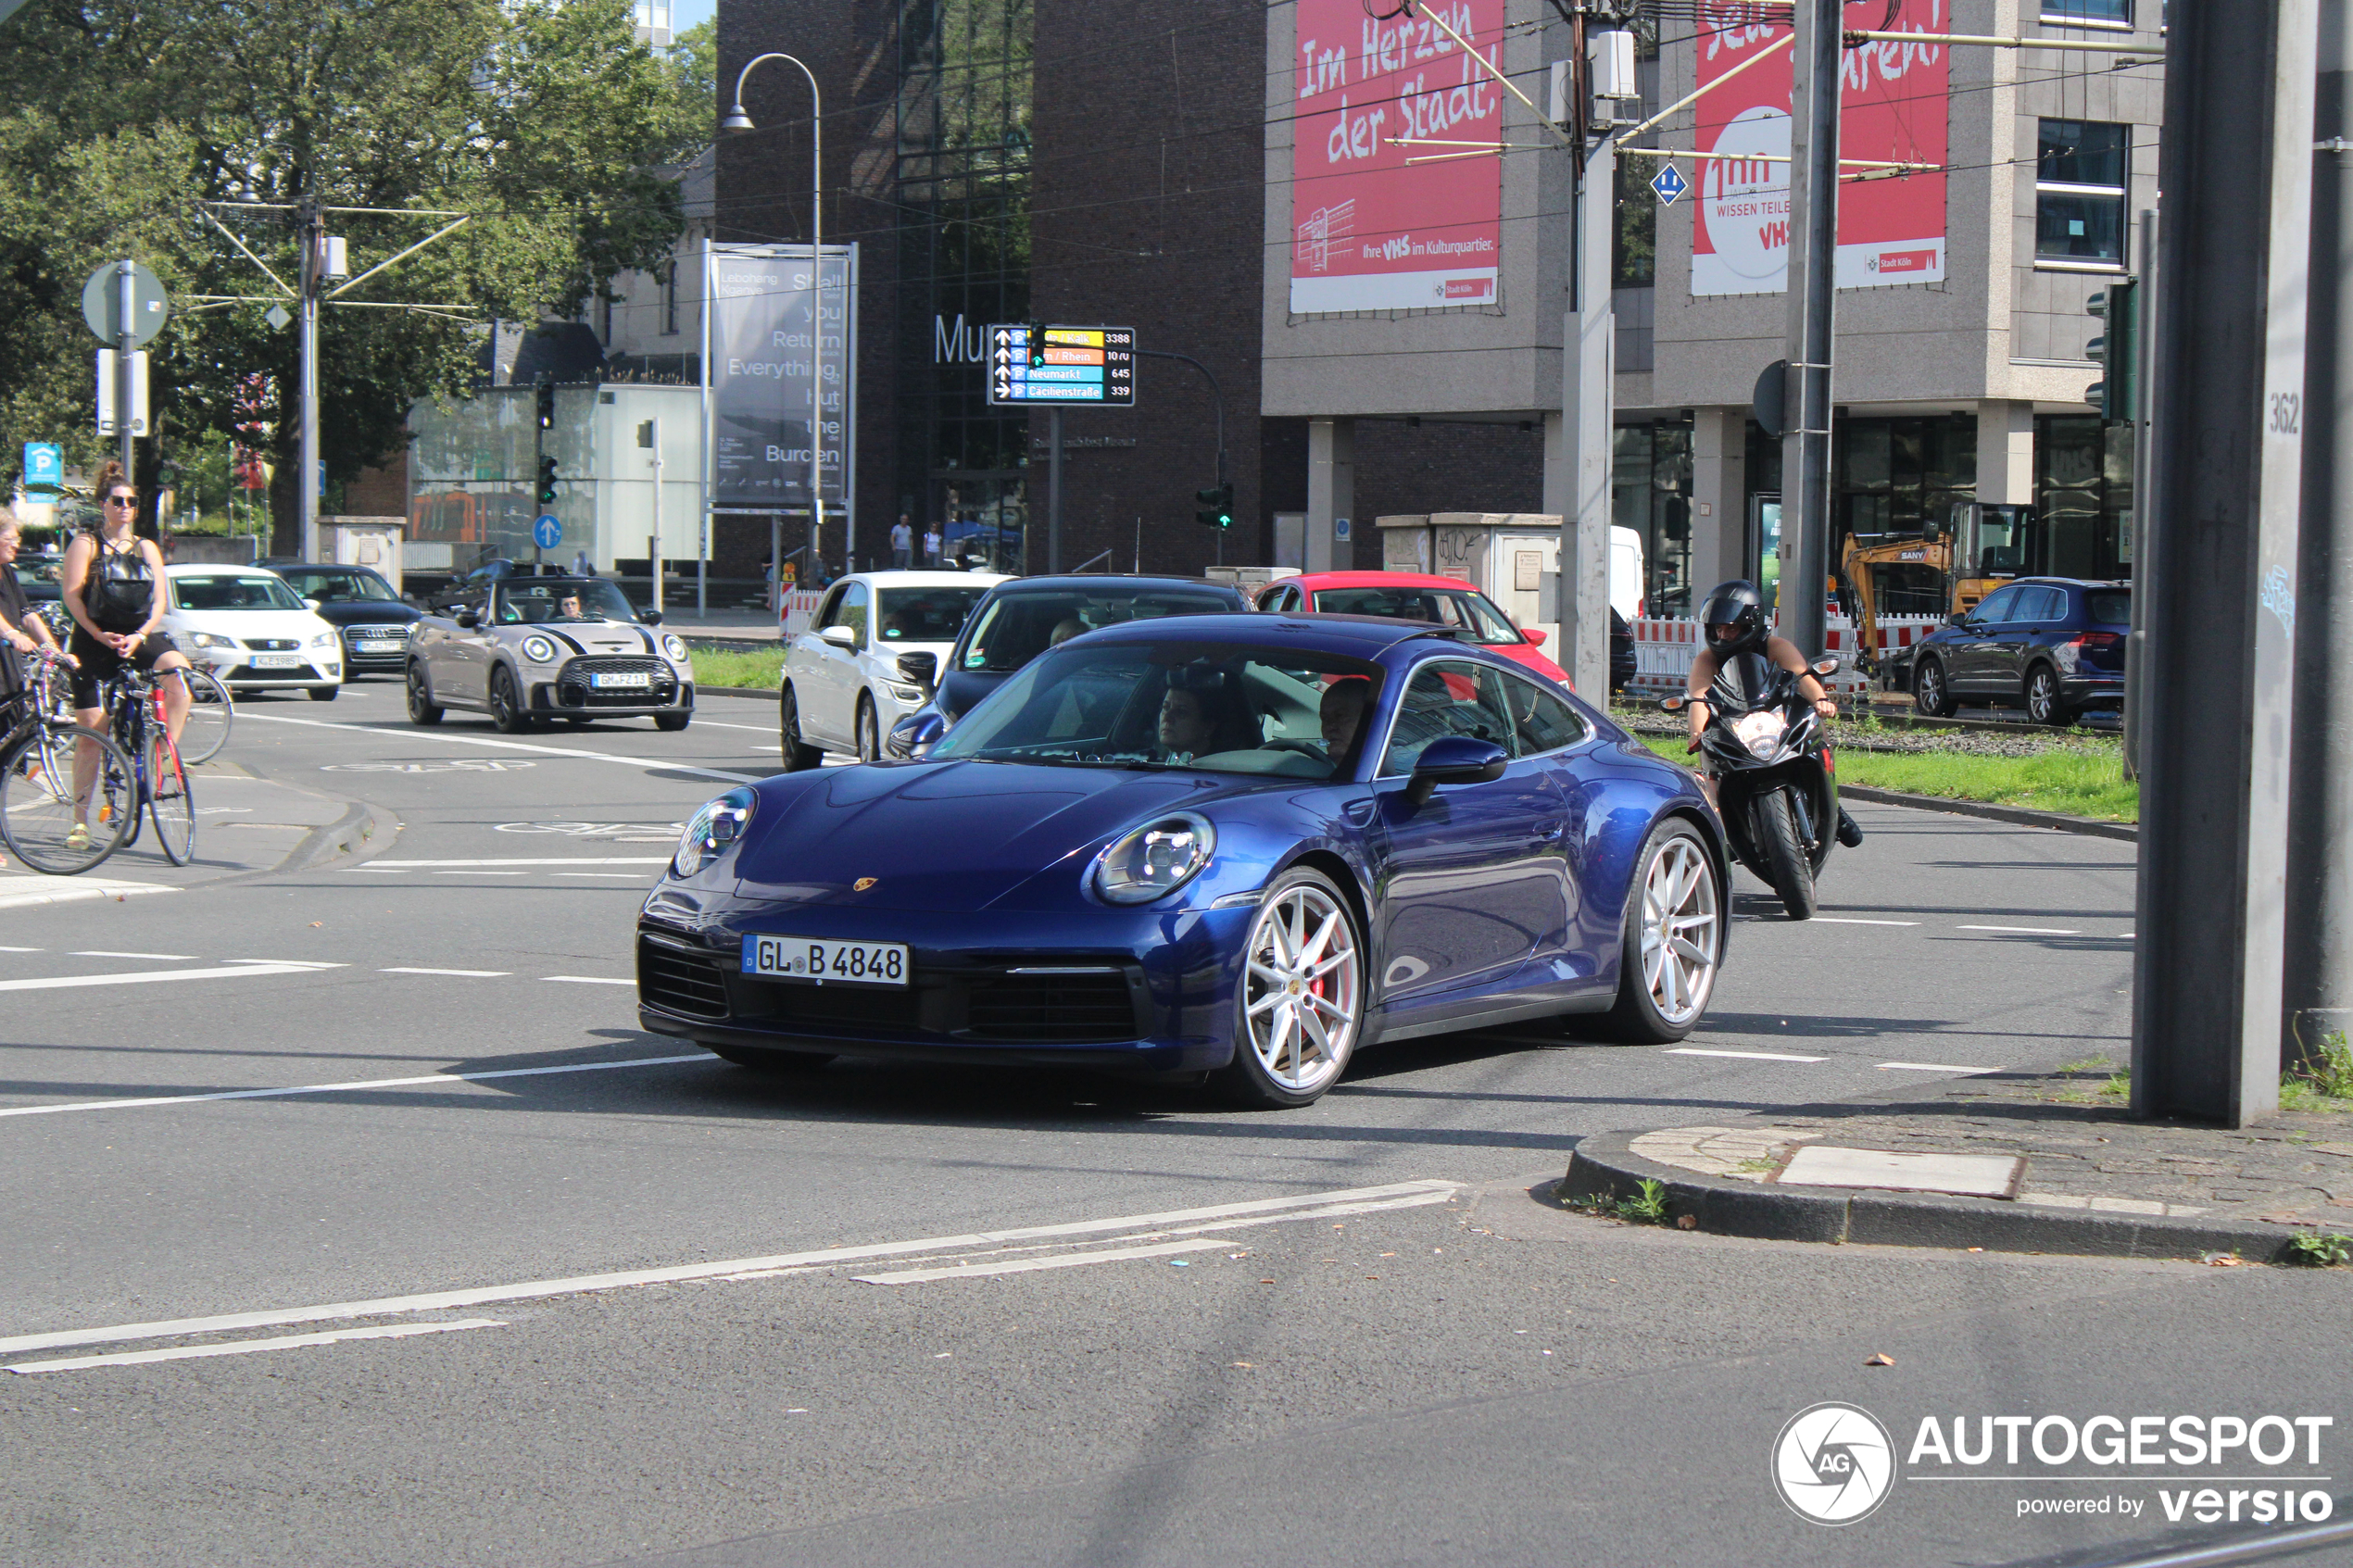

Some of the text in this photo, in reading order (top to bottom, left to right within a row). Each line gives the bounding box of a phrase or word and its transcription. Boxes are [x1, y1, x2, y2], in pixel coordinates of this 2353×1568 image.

[1300, 1, 1475, 99] Im Herzen
[1327, 44, 1497, 163] der Stadt!
[1717, 203, 1757, 218] WISSEN
[1363, 234, 1494, 260] Ihre VHS im Kulturquartier.
[1881, 257, 1912, 268] Stadt Köln
[721, 272, 778, 286] Lebohang
[936, 313, 988, 363] Mu
[1066, 333, 1090, 344] Kalk
[1105, 333, 1130, 344] 3388
[1062, 352, 1091, 362] Rhein
[1107, 351, 1130, 361] 1070
[1029, 370, 1081, 379] Neumarkt
[1112, 369, 1130, 379] 645
[1028, 385, 1101, 397] Cäcilienstraße
[1111, 385, 1130, 395] 339
[2270, 392, 2298, 433] 362
[1901, 551, 1924, 559] SANY
[601, 674, 646, 684] GM FZ 13
[759, 940, 902, 979] GL B 4848
